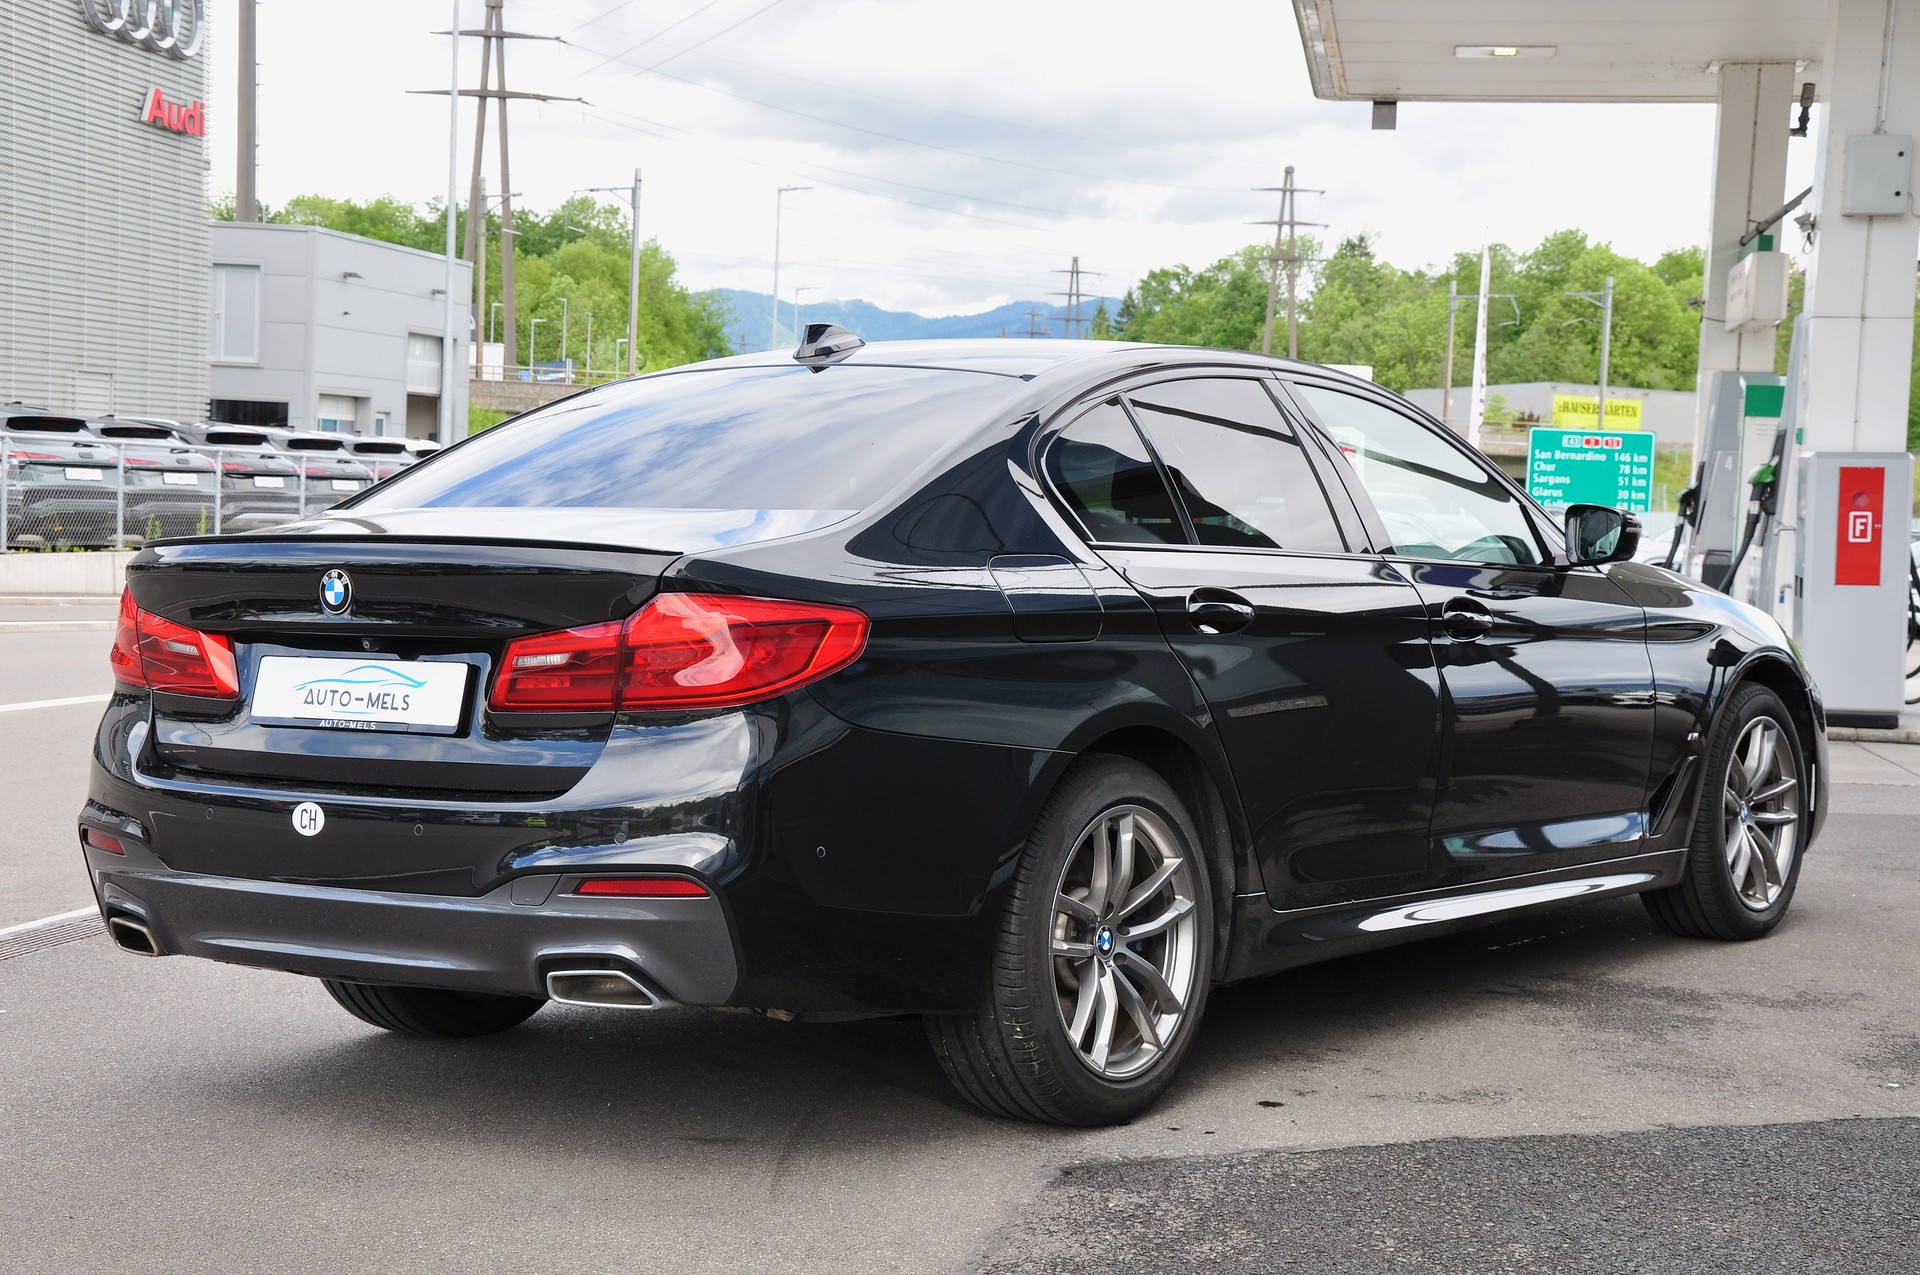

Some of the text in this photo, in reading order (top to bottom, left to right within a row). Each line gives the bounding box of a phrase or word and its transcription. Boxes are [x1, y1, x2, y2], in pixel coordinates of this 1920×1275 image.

[145, 86, 206, 138] Audi
[1534, 449, 1649, 463] San Bernardino 146 km
[1724, 455, 1733, 471] 4
[1533, 461, 1648, 475] Chur 78 km
[1532, 473, 1647, 487] Sargans 51 km
[1532, 486, 1646, 500] Glarus 30 km
[1630, 502, 1646, 512] km
[1855, 518, 1867, 537] F
[322, 571, 349, 585] BMW
[303, 687, 410, 711] AUTO-MELS
[319, 719, 377, 731] AUTO-MELS
[300, 808, 317, 830] CH
